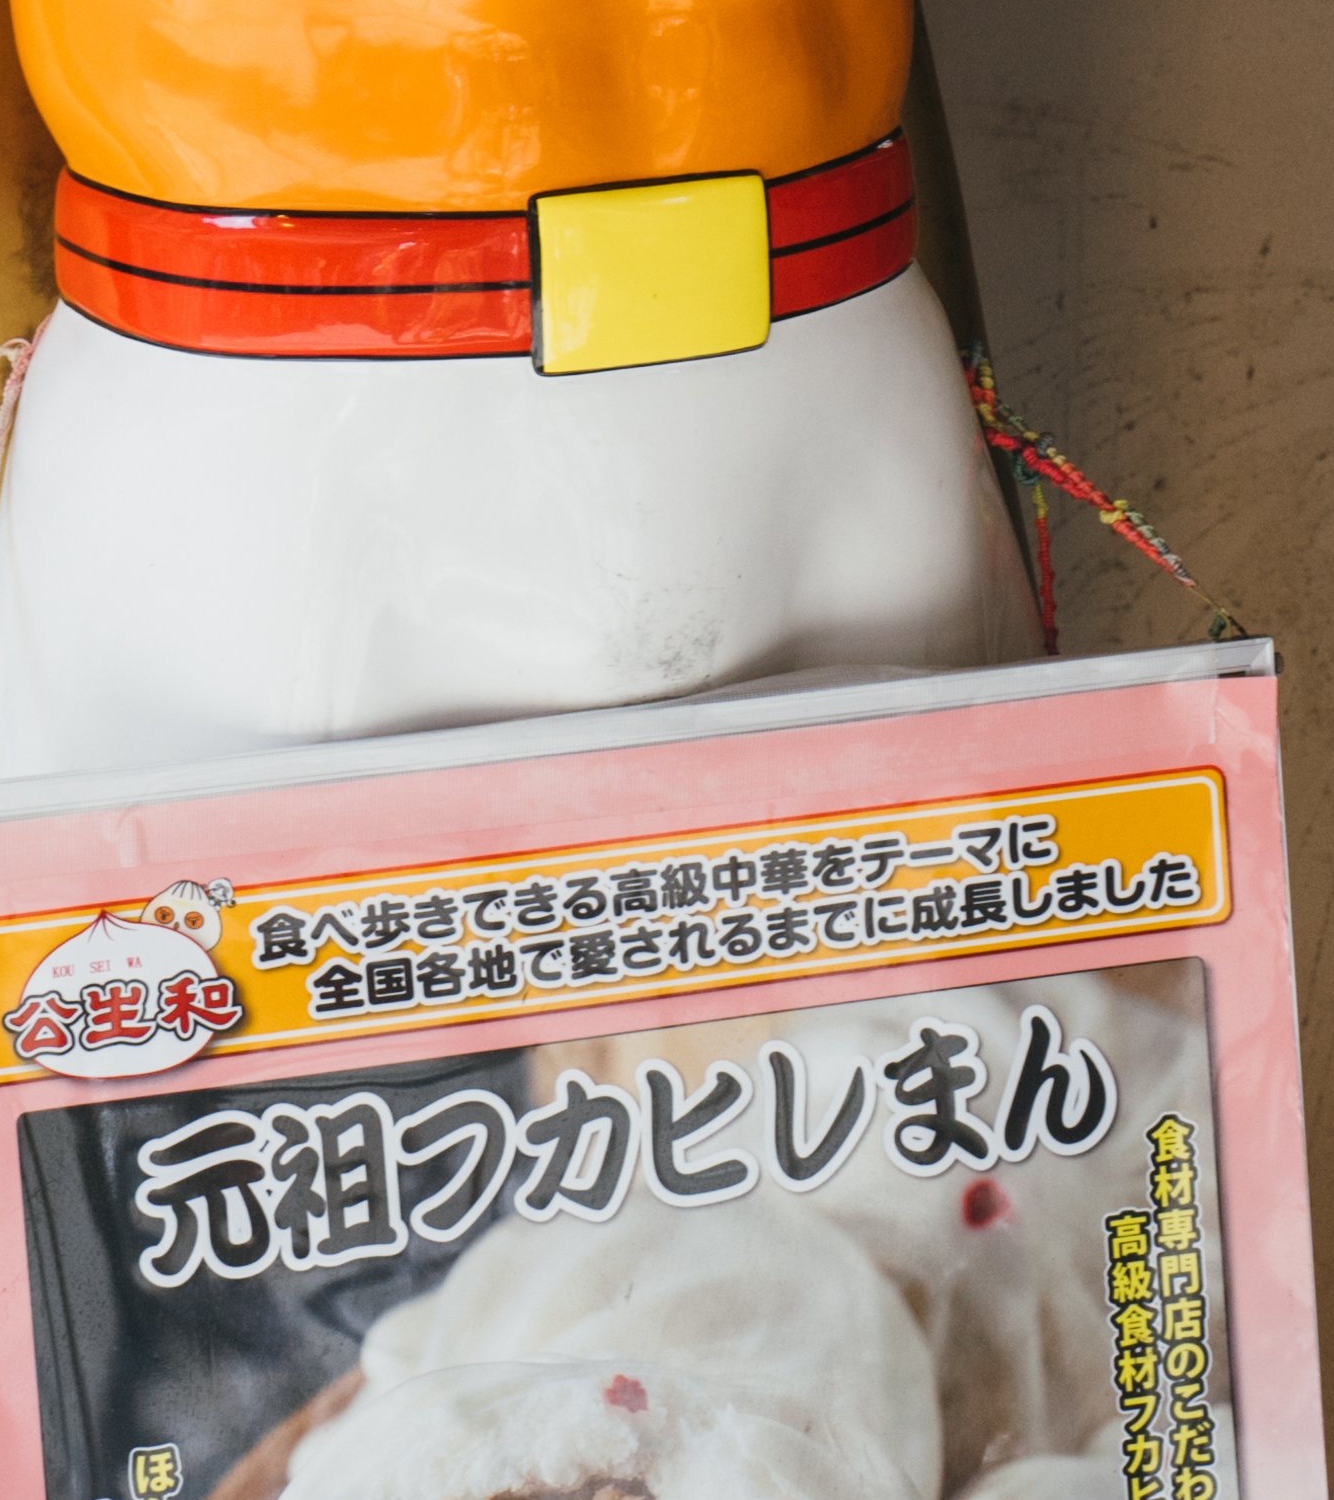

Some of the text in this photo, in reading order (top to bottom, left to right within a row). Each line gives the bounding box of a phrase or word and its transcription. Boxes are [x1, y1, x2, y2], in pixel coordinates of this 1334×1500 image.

[255, 818, 1053, 963] 食べ歩きできる高級中華をテーマに
[312, 857, 1197, 1013] 全国各地で愛されるまでに成長しました
[7, 974, 241, 1055] 公生和
[52, 957, 142, 978] KOU SEI WA
[143, 1012, 1113, 1282] 元祖フカヒレまん
